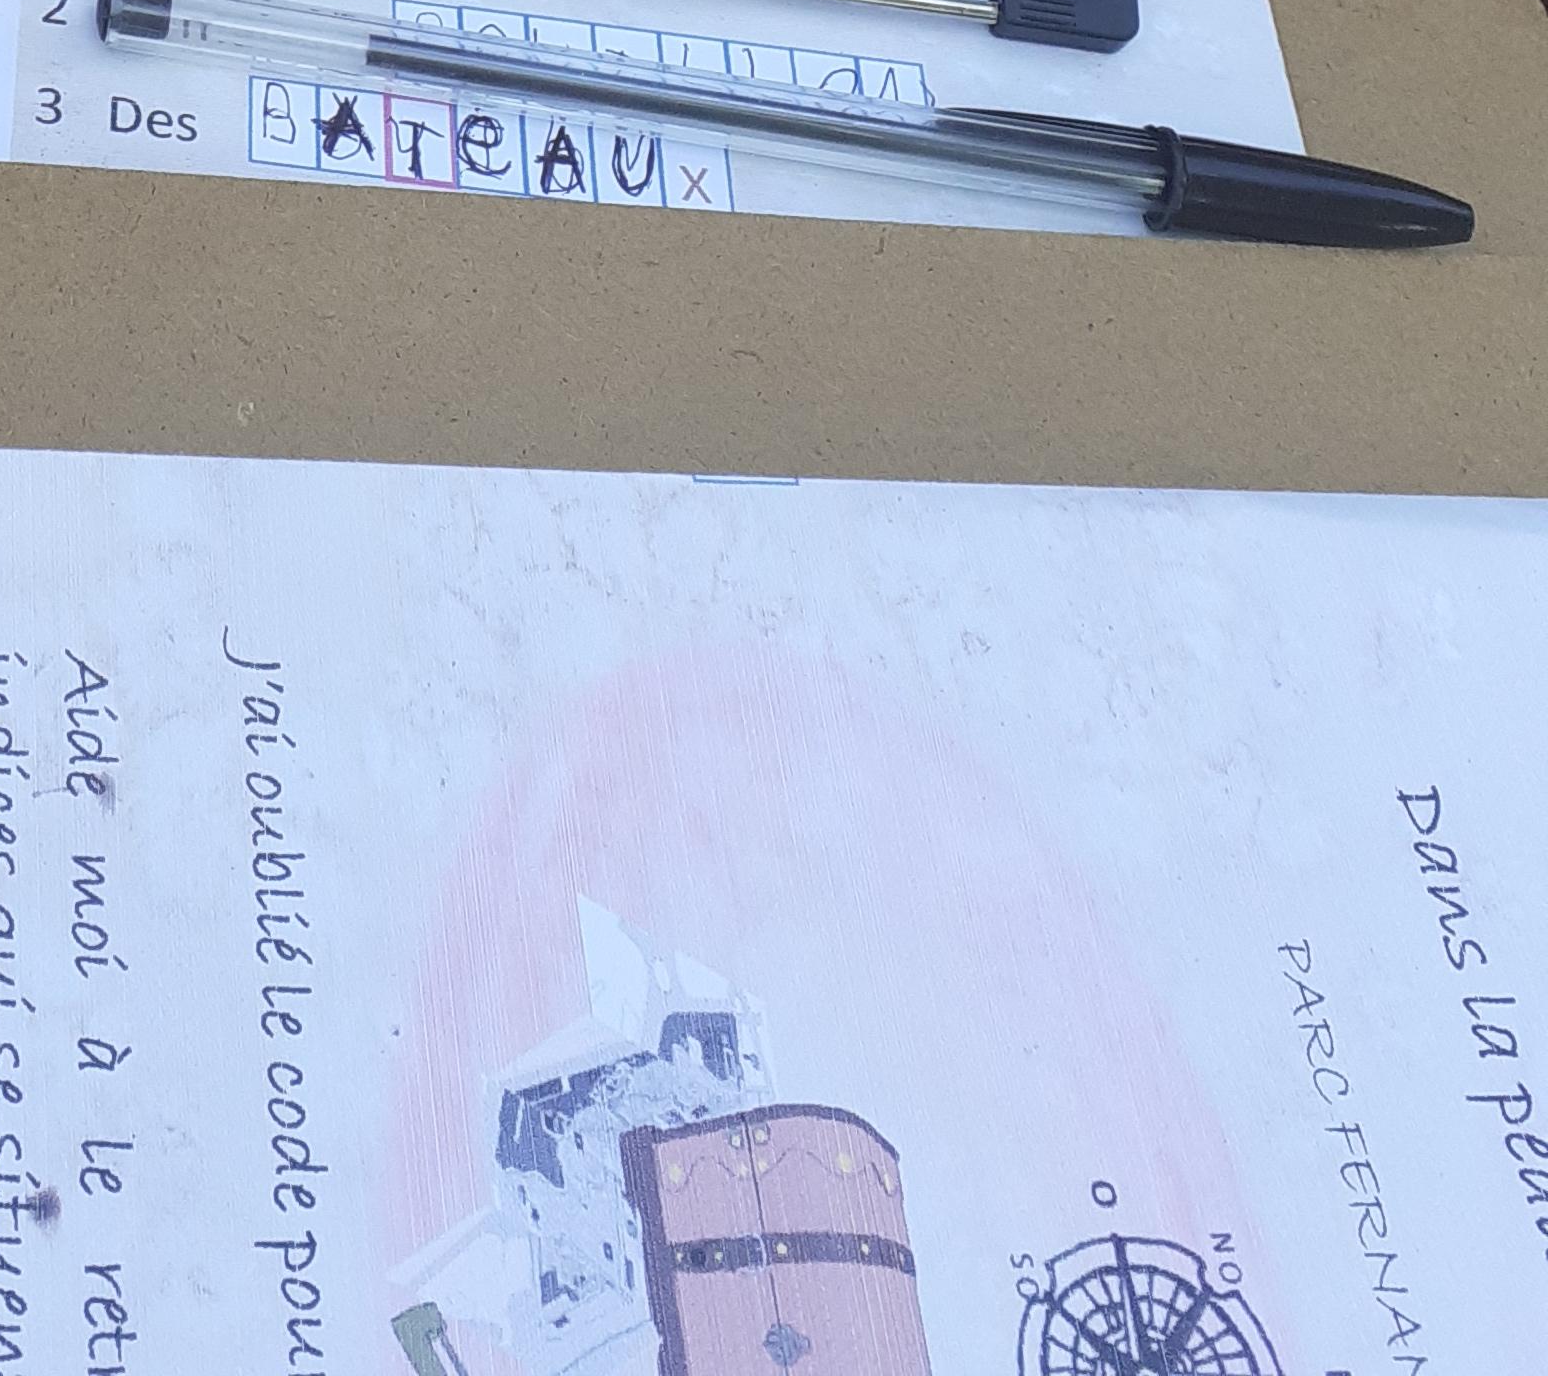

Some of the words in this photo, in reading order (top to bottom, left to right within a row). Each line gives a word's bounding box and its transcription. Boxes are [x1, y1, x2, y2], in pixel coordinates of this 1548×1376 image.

[34, 87, 64, 125] 3
[110, 95, 199, 142] Des
[65, 648, 106, 798] Aide
[223, 625, 296, 755] J'ai
[70, 853, 129, 978] moi
[245, 771, 313, 967] oublié
[76, 1033, 119, 1073] à
[259, 987, 313, 1039] le
[1278, 938, 1351, 1105] PARC
[78, 1130, 124, 1197] le
[266, 1061, 329, 1214] code
